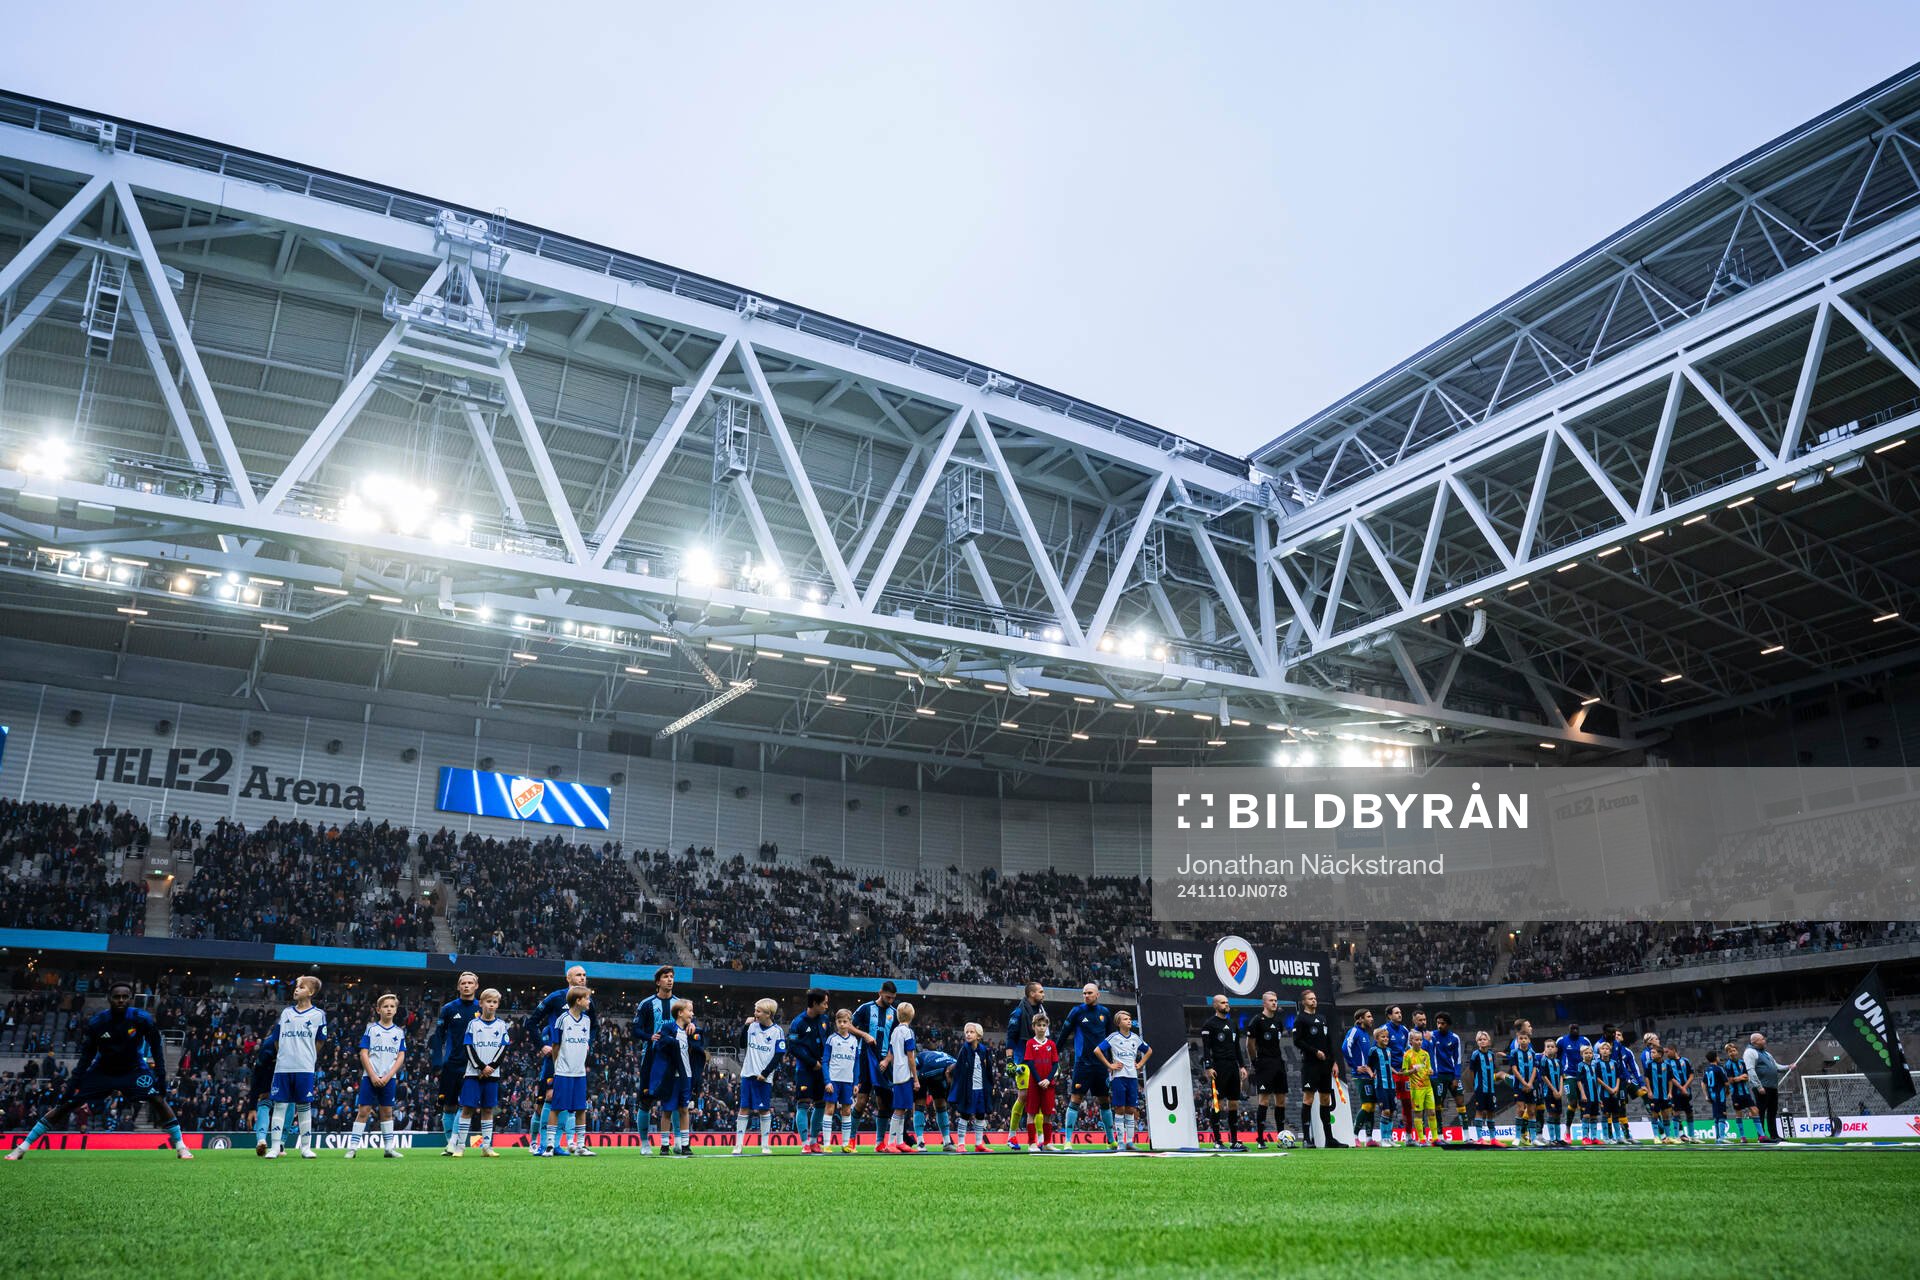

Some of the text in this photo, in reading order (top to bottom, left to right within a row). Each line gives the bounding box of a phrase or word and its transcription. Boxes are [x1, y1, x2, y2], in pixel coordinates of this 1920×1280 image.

[93, 748, 367, 811] TELE2 Arena
[1598, 794, 1640, 812] Arena
[1145, 950, 1202, 969] UNIBET
[1269, 959, 1320, 977] UNIBET
[281, 1029, 313, 1038] HOLMEN
[1162, 1086, 1178, 1111] U
